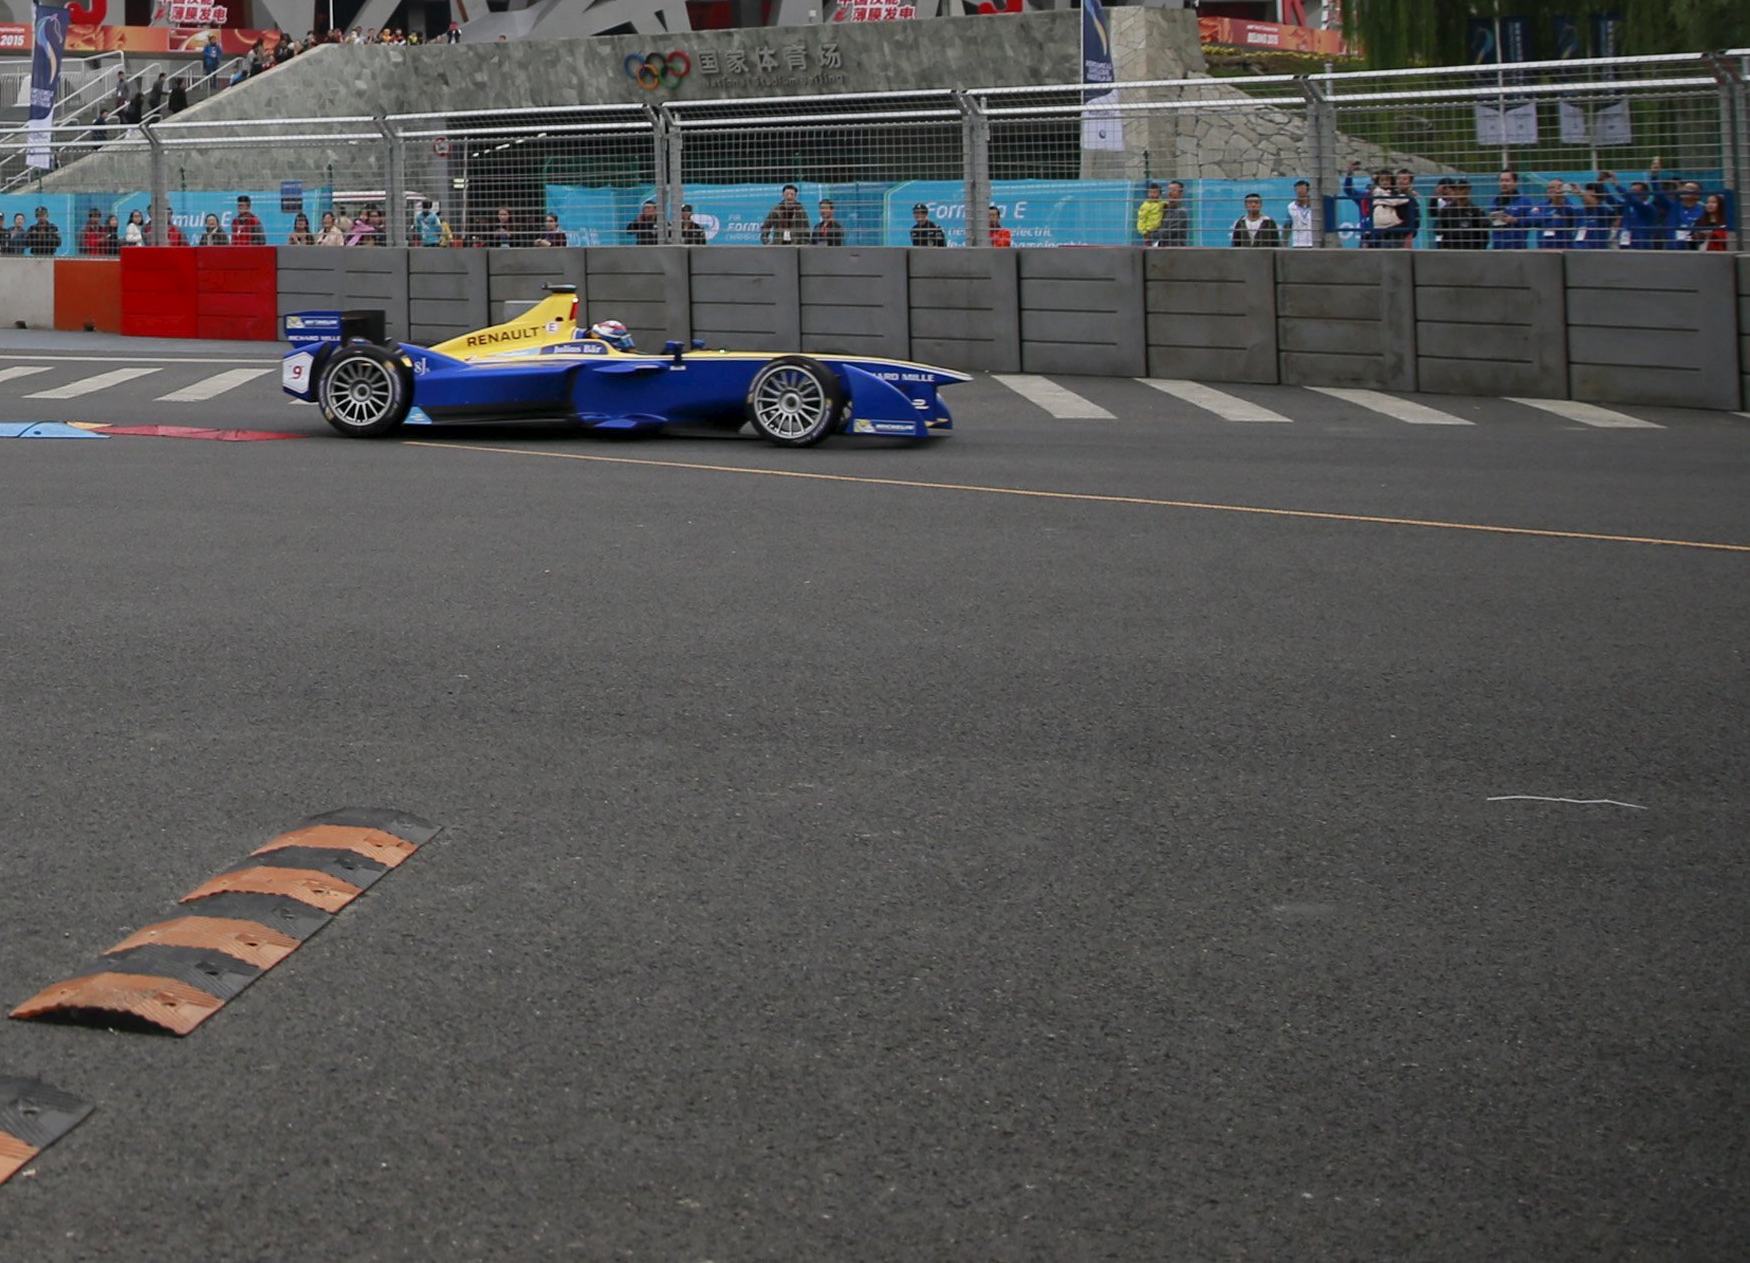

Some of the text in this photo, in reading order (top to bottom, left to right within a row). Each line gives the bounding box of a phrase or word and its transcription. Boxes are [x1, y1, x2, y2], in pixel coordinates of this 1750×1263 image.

[171, 6, 226, 22] 薄膜发电
[0, 34, 25, 47] 2015
[697, 43, 843, 75] 国家体育场
[1014, 201, 1028, 219] E
[466, 326, 540, 348] RENAULT
[553, 344, 603, 354] Julius Bär
[292, 365, 303, 380] 9
[901, 373, 935, 383] MILLE
